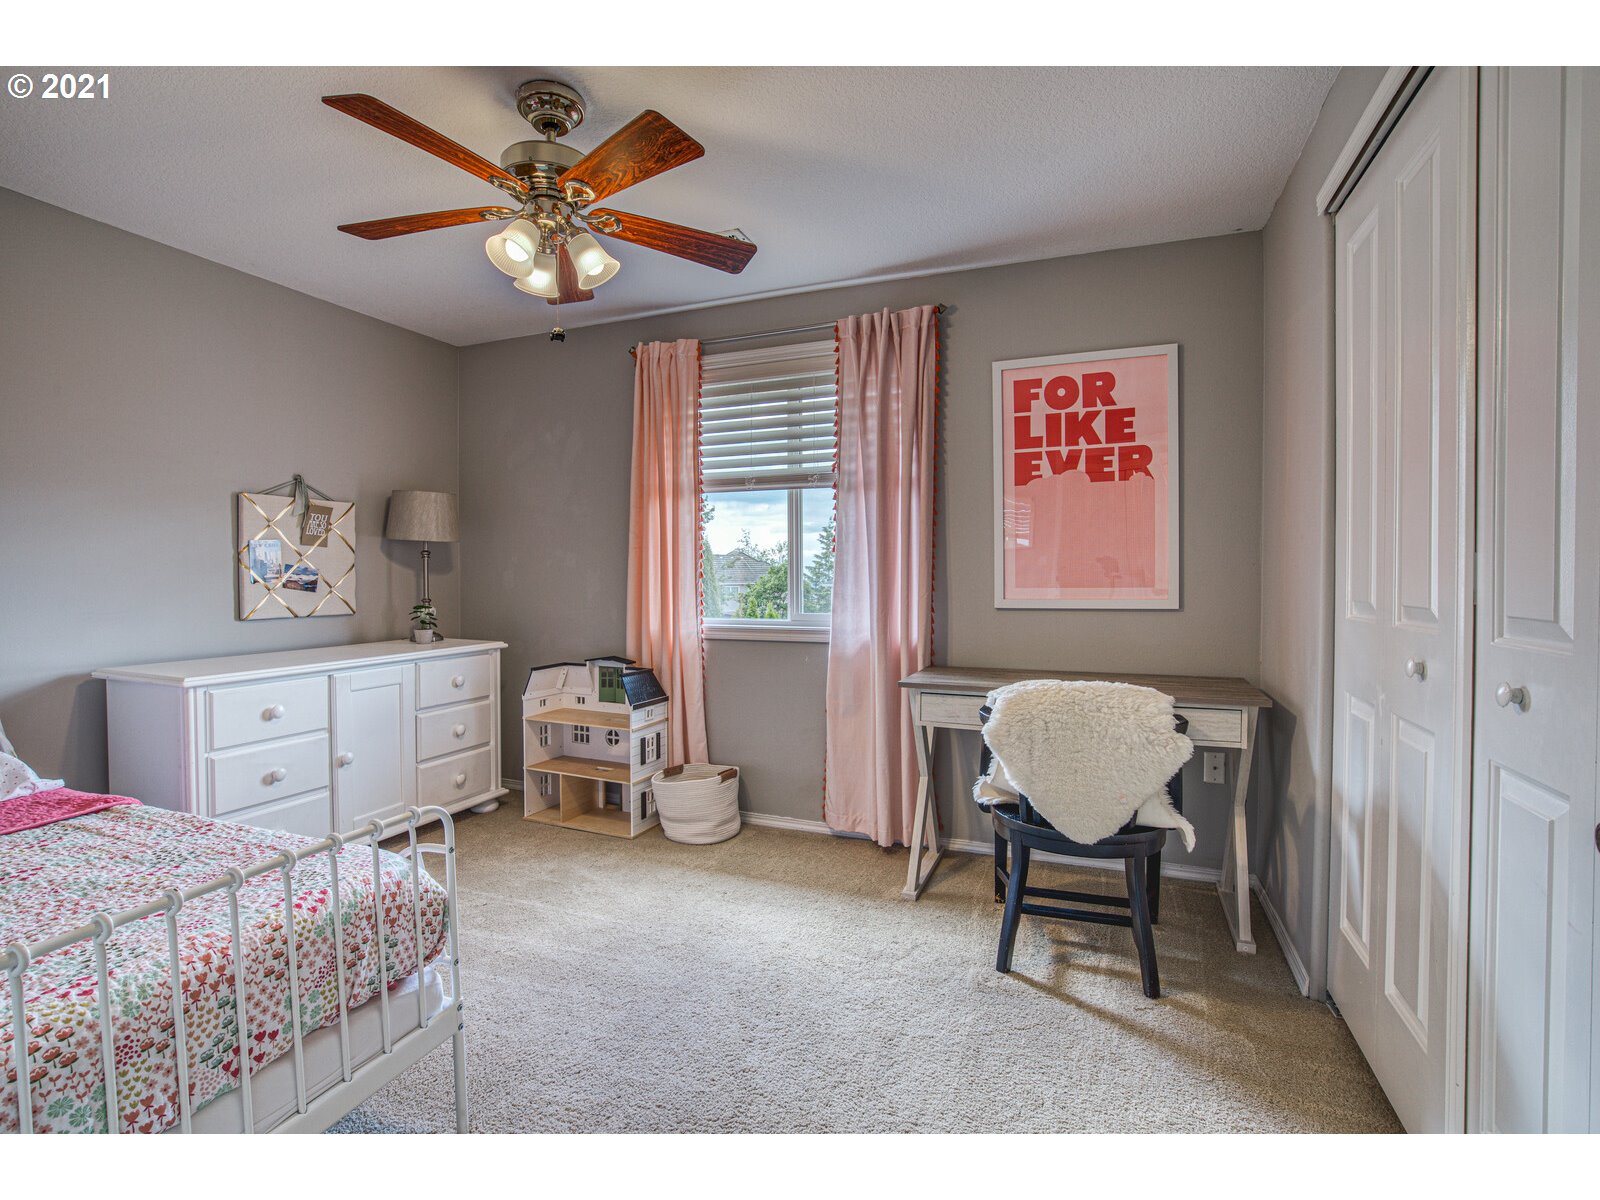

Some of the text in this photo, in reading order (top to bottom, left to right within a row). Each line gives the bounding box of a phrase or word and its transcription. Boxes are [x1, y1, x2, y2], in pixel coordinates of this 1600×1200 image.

[1013, 371, 1118, 414] FOR
[1014, 407, 1136, 450] LIKE
[1014, 444, 1155, 487] EVER
[310, 513, 328, 522] YOU
